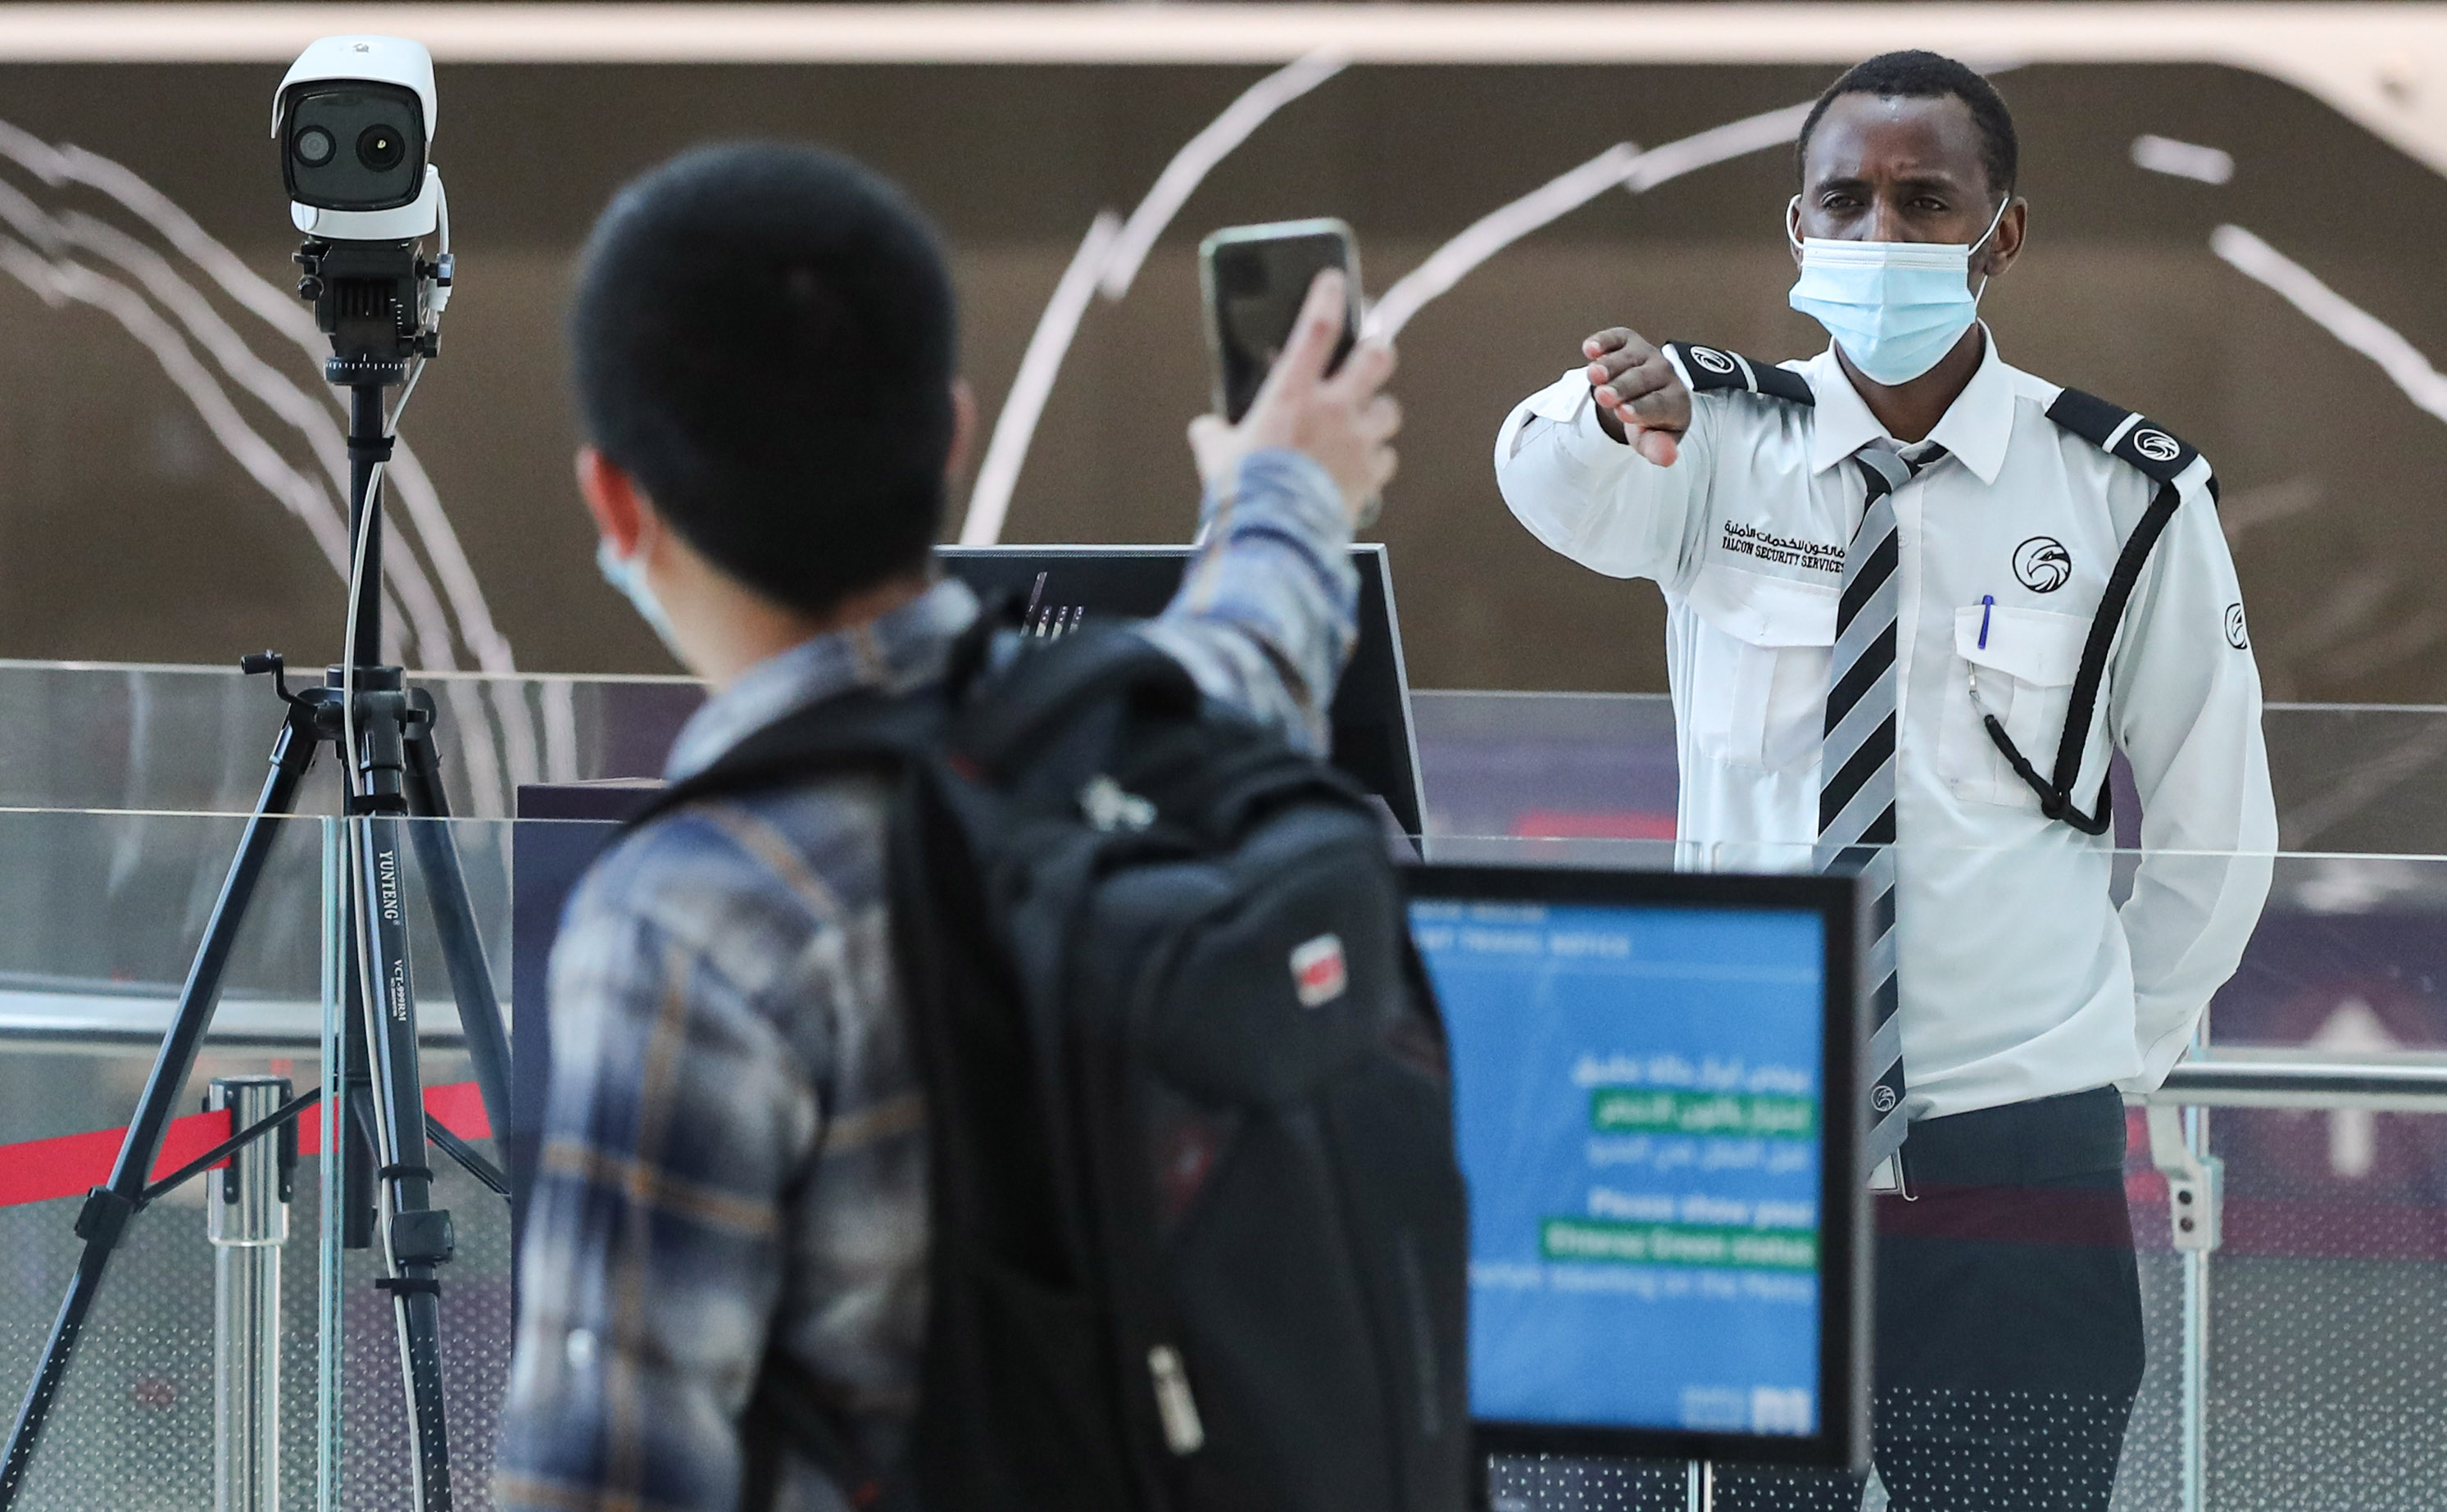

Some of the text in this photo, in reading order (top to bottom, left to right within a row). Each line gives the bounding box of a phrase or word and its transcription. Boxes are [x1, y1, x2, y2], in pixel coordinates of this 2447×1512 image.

[1722, 536, 1755, 555] FALCON
[1755, 545, 1800, 565] SECURITY
[379, 850, 400, 919] YUNTENG
